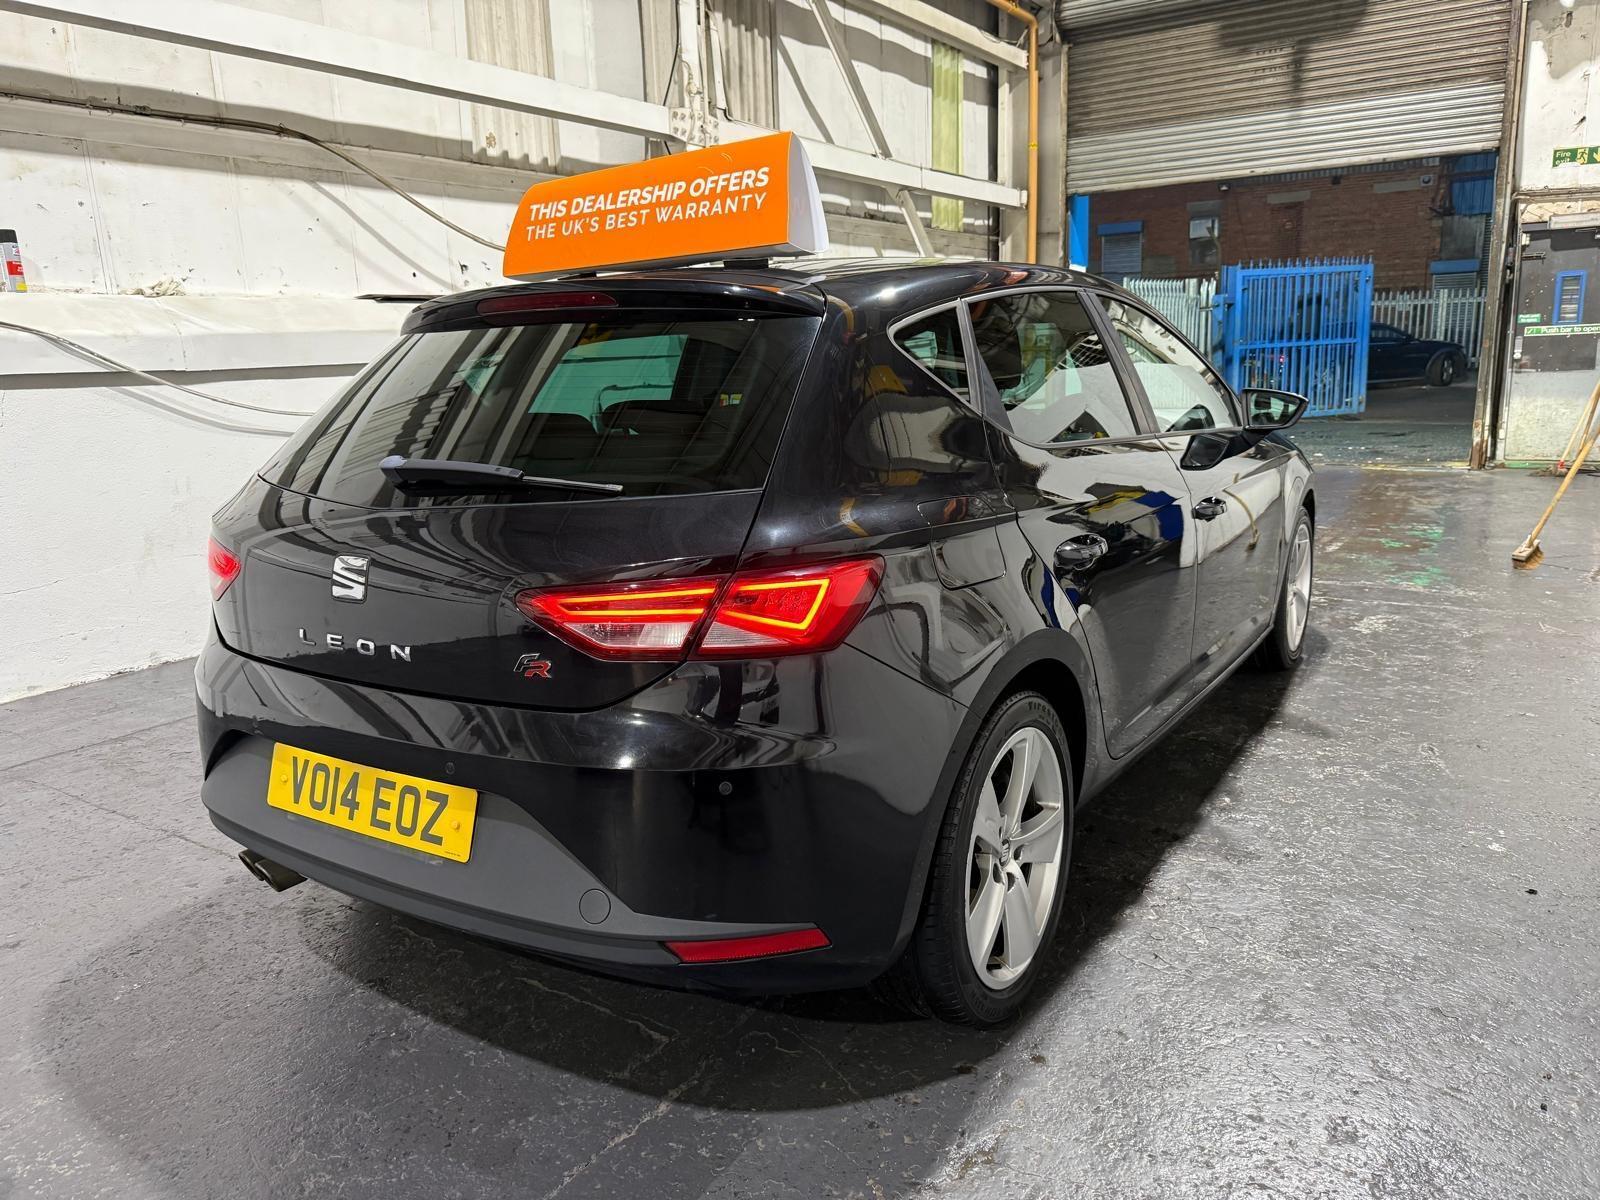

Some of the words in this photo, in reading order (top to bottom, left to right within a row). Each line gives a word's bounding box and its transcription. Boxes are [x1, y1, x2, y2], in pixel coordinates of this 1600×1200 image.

[525, 221, 556, 241] THE
[561, 216, 600, 236] UK'S
[604, 208, 651, 231] BEST
[655, 192, 767, 224] WARRANTY
[529, 201, 567, 222] THIS
[569, 181, 687, 216] DEALERSHIP
[688, 166, 770, 198] OFFERS
[299, 627, 412, 662] LEON
[513, 653, 553, 679] FR
[292, 756, 360, 821] VO14
[369, 776, 450, 846] EOZ
